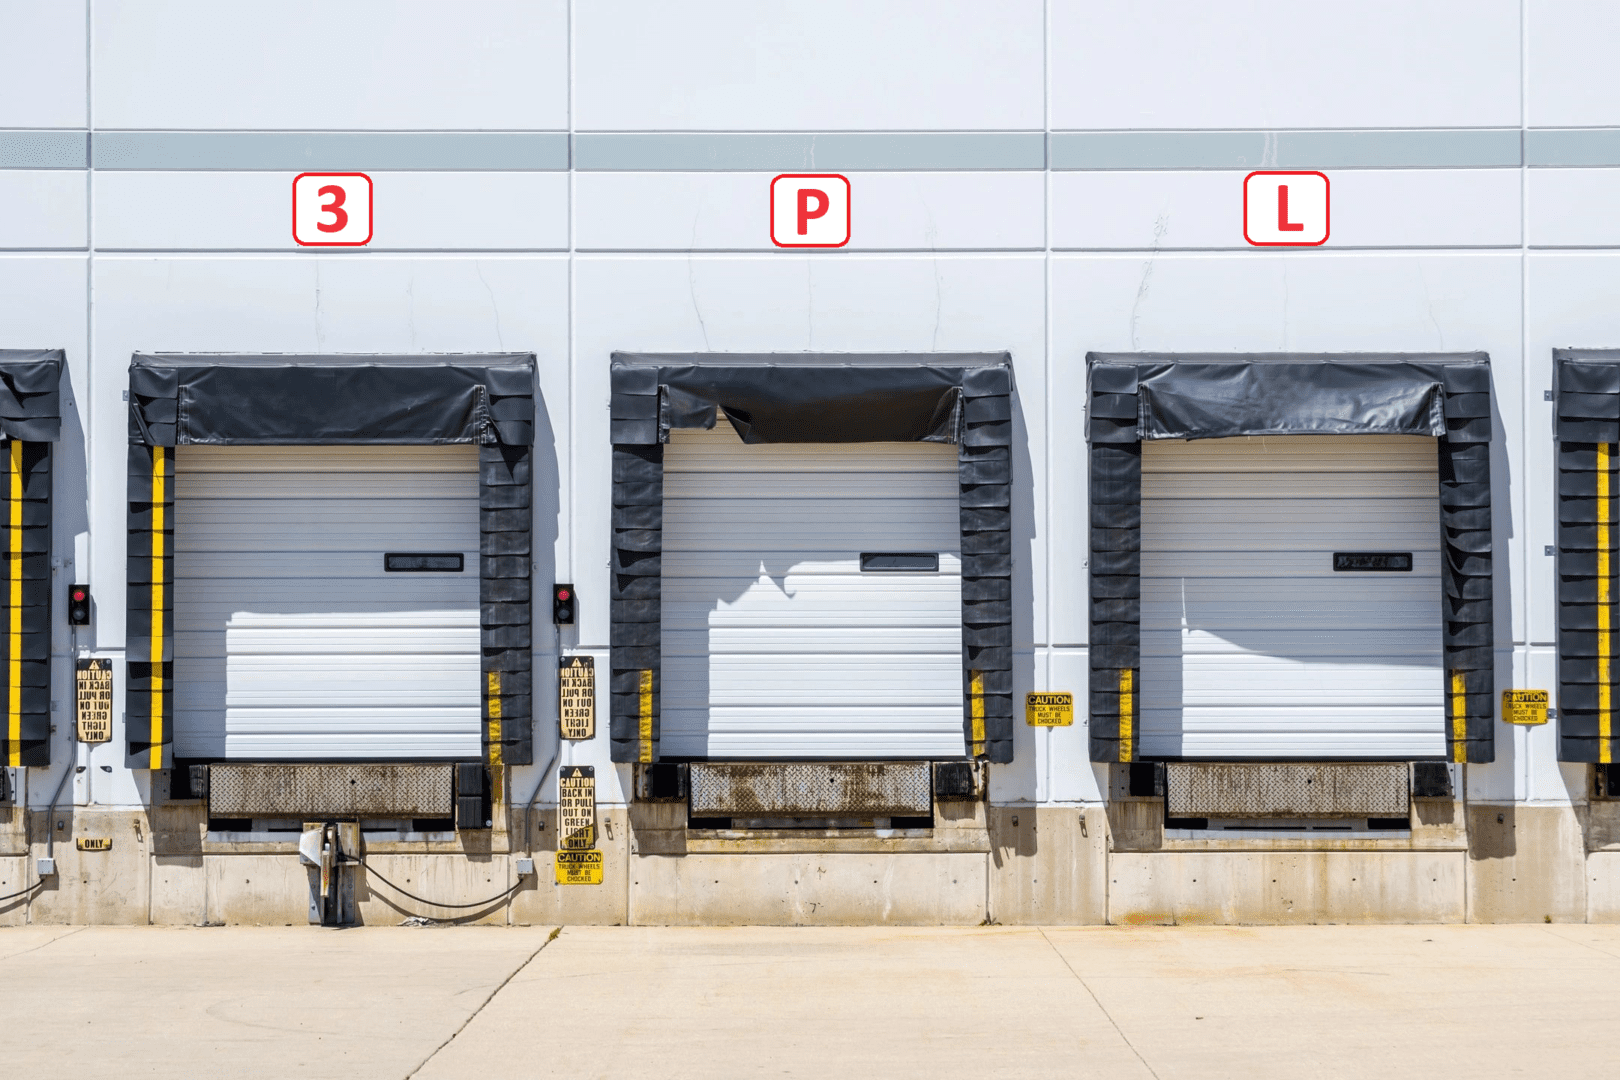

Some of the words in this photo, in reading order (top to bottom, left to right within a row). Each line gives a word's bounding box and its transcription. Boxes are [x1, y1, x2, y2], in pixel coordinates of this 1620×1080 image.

[1028, 696, 1071, 704] CAUTION
[1505, 692, 1547, 701] CAUTION
[560, 778, 595, 787] CAUTION
[562, 789, 582, 797] BACK
[585, 789, 592, 797] IN
[562, 799, 572, 807] OR
[575, 799, 592, 807] PULL
[563, 809, 578, 817] OUT
[581, 809, 591, 817] ON
[565, 818, 590, 826] GREEN
[566, 828, 589, 838] LIGHT
[85, 839, 103, 848] ONLY
[568, 839, 586, 847] ONLY
[558, 853, 601, 861] CAUTION
